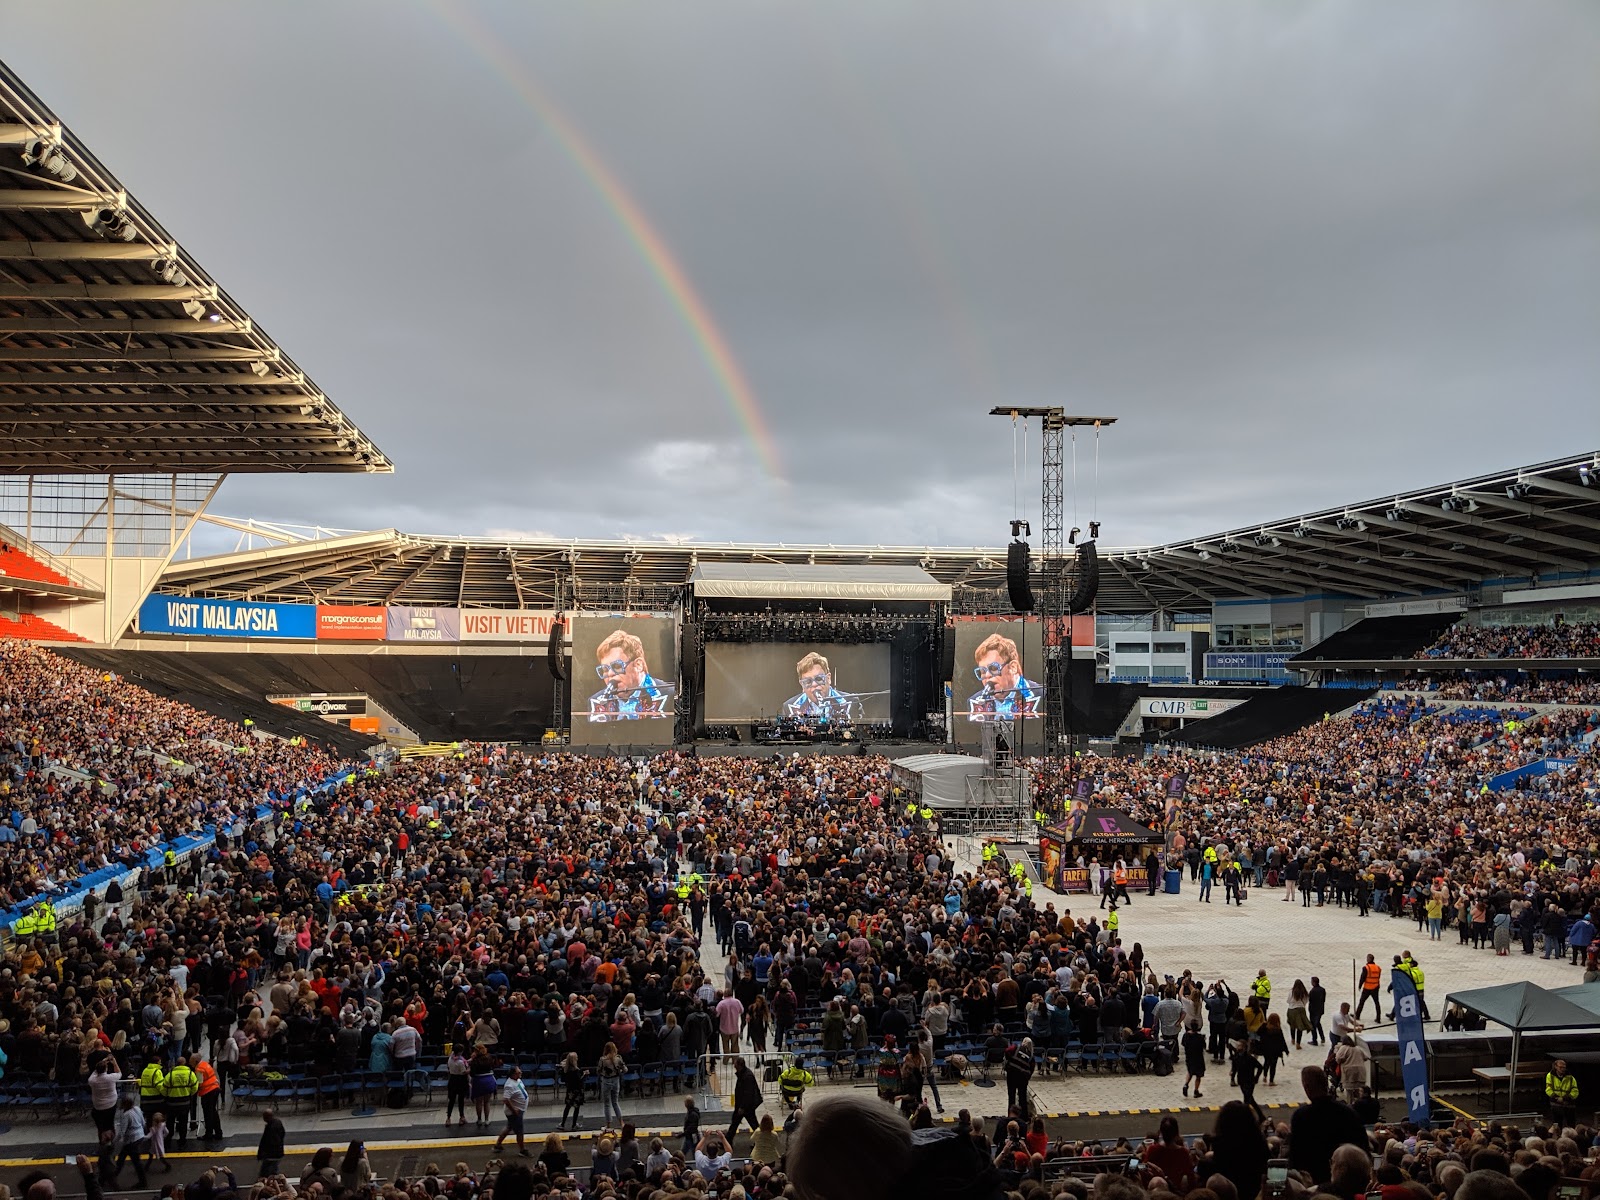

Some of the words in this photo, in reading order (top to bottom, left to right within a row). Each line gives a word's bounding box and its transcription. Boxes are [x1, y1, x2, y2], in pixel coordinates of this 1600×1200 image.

[167, 602, 199, 628] VISIT
[203, 605, 278, 631] MALAYSIA
[413, 608, 434, 618] VISIT
[321, 615, 383, 624] morgansconsult
[465, 615, 502, 634] VISIT
[404, 629, 442, 640] MALAYSIA
[1149, 700, 1185, 714] CMB
